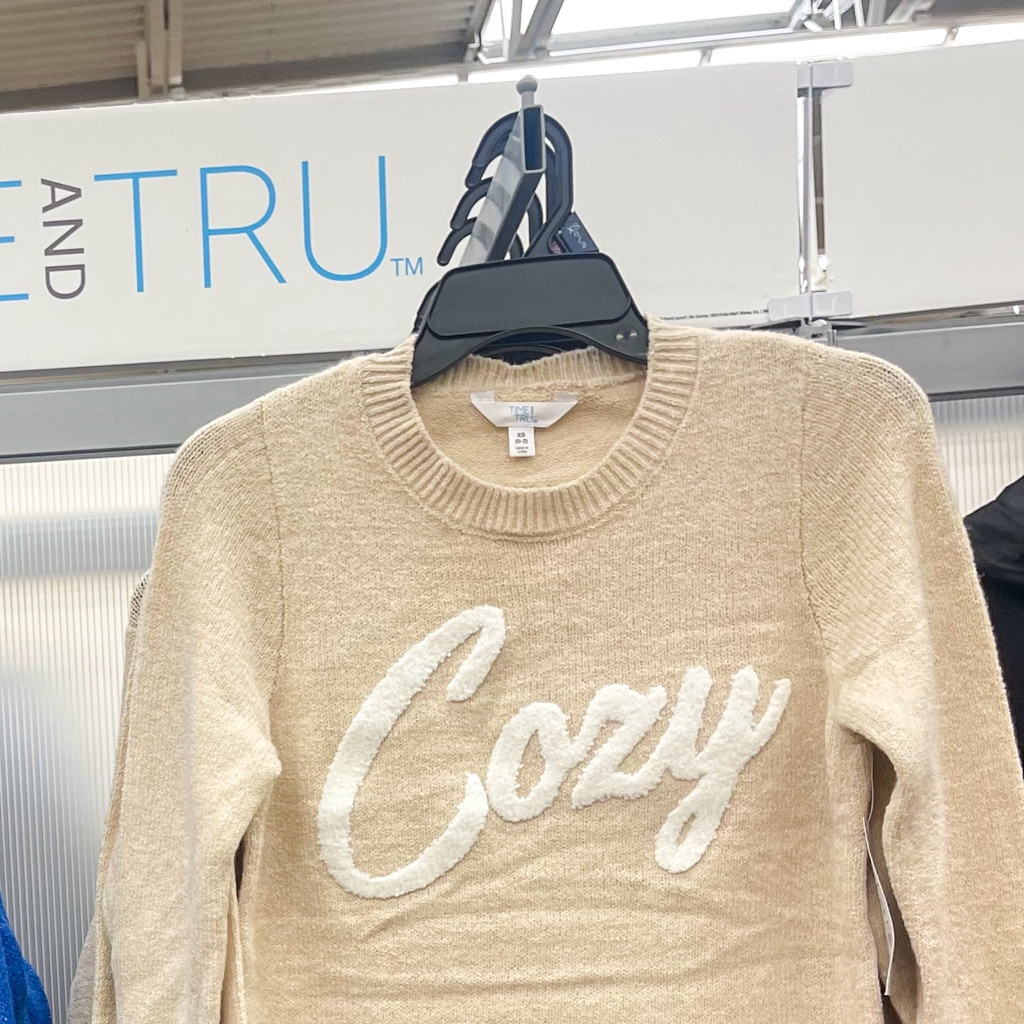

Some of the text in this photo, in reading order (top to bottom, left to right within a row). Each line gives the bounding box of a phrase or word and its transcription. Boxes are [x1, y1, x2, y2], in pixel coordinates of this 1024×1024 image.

[40, 178, 86, 300] AND
[94, 155, 388, 293] TRU
[509, 406, 529, 414] TIME
[317, 604, 791, 899] Cozy
